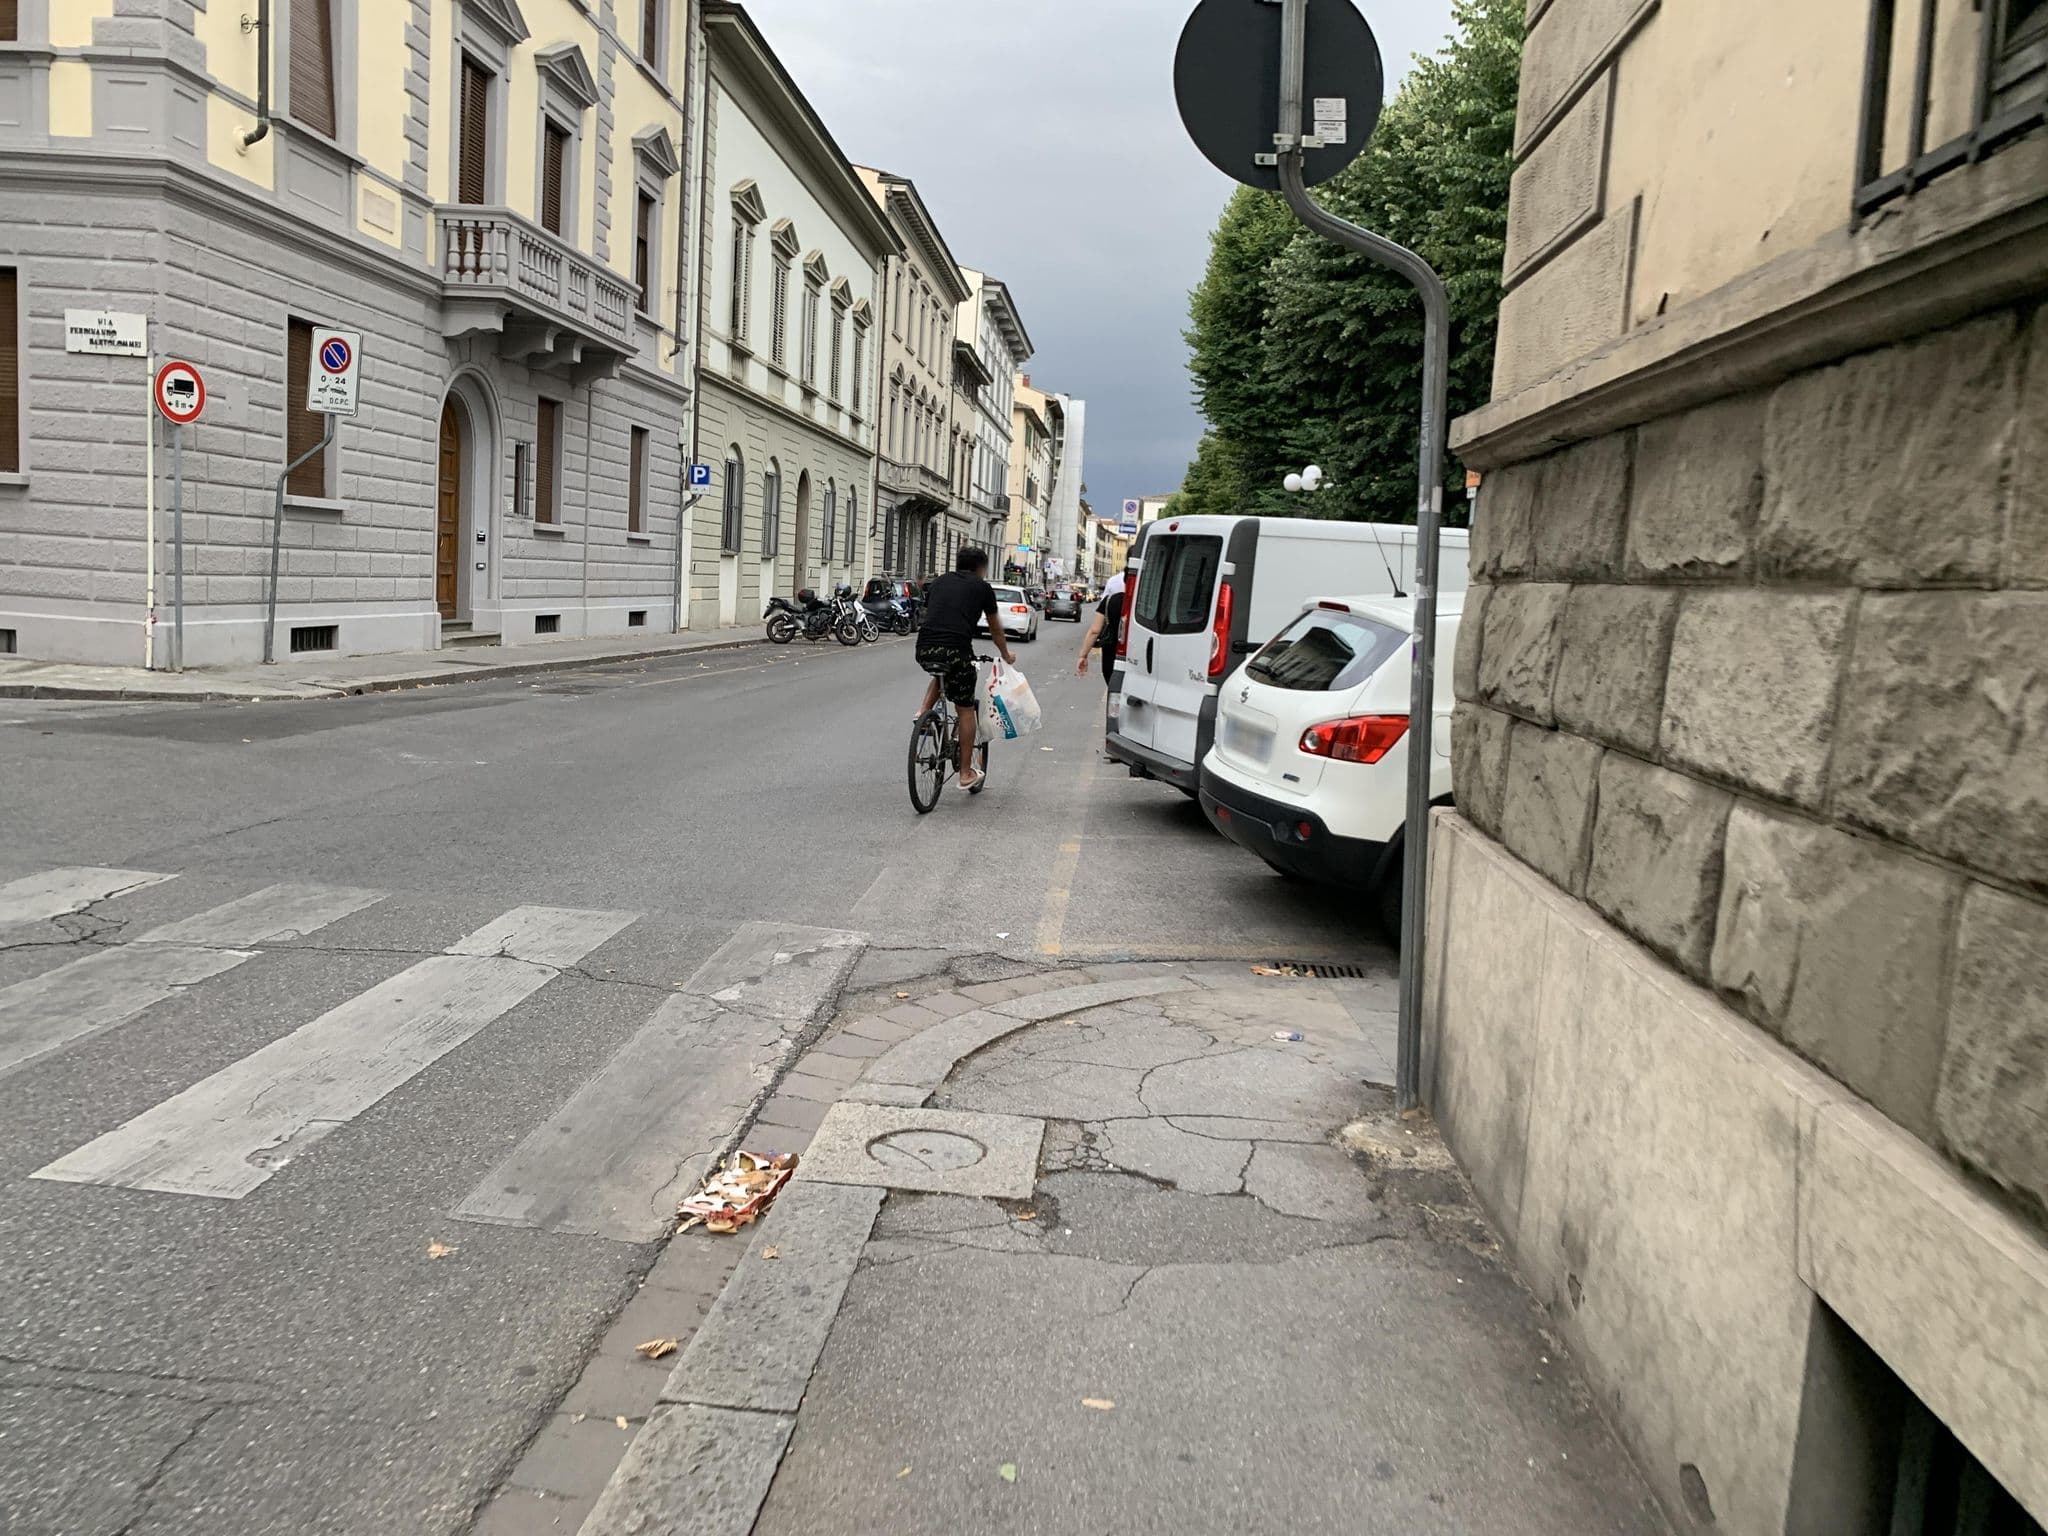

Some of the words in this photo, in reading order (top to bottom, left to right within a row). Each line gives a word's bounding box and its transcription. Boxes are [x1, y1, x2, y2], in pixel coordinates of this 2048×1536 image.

[98, 318, 113, 327] VIA
[70, 327, 117, 337] FERDINANDO
[89, 338, 142, 348] BARTOLOMMEI
[321, 375, 326, 383] 0
[335, 377, 346, 385] 24
[693, 467, 706, 483] P
